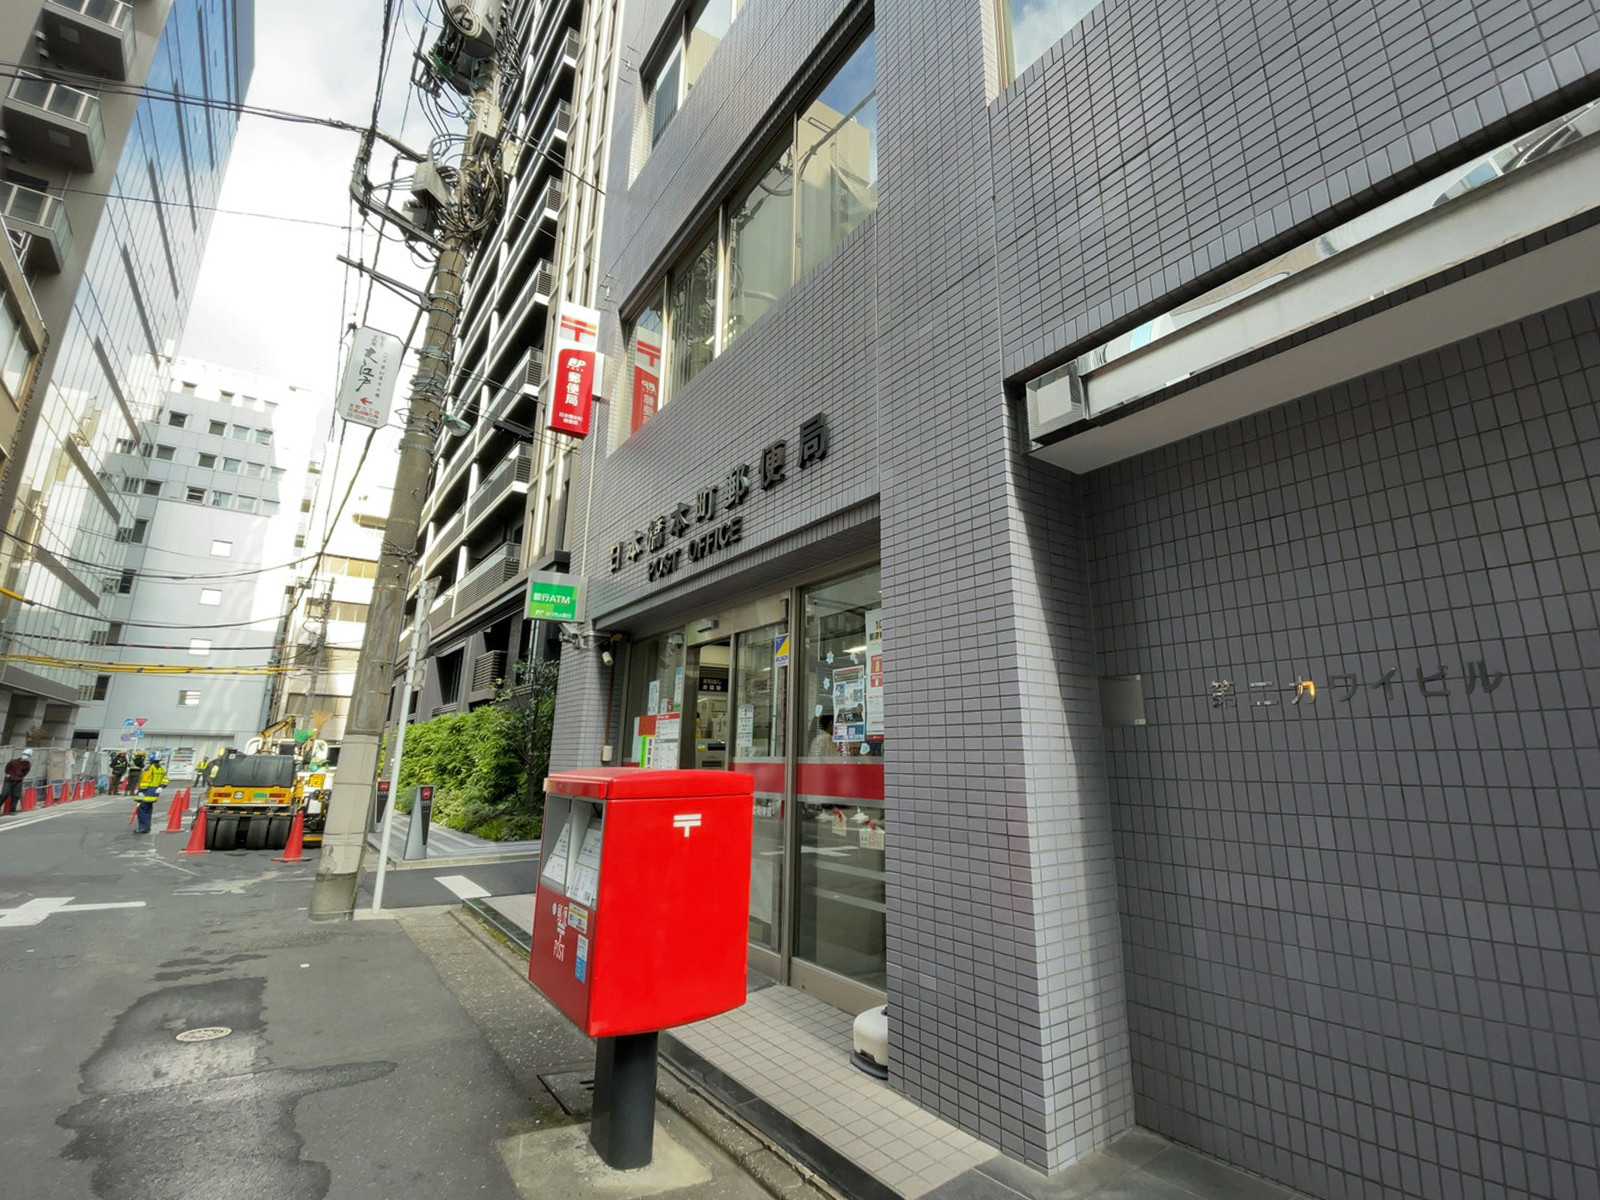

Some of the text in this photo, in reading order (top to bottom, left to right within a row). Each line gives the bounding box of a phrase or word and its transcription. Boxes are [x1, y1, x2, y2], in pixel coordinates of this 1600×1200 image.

[565, 372, 581, 406] 郵便局
[610, 412, 830, 572] 日本橋本町郵便局
[648, 516, 744, 582] POST OFFICE
[533, 592, 571, 604] 銀行ATM
[1211, 662, 1502, 709] 第二カワイビル
